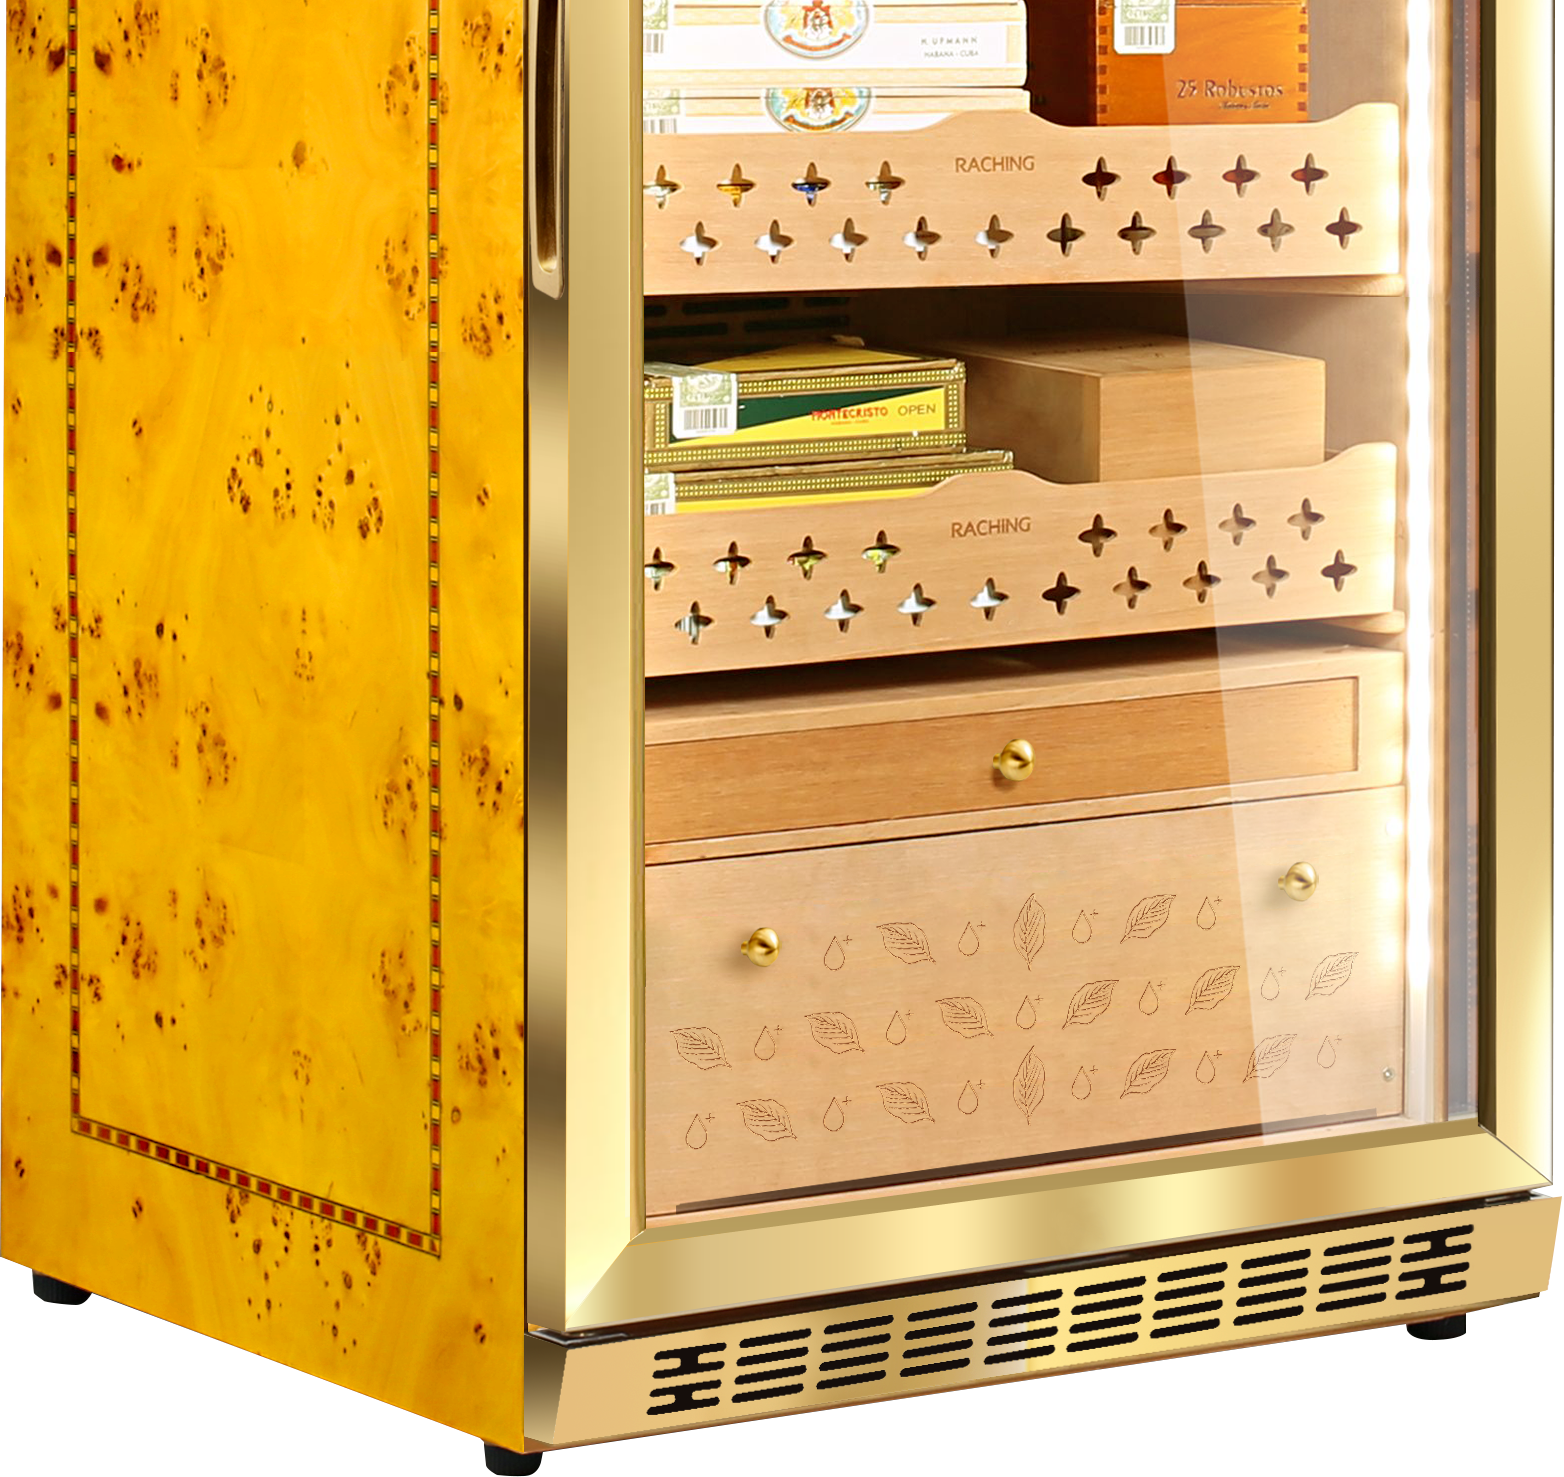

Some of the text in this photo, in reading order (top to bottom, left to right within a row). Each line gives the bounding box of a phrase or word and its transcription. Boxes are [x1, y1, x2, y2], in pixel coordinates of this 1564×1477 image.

[955, 155, 1035, 173] RACHING
[897, 403, 937, 417] OPEN
[951, 516, 1032, 538] RACHING
